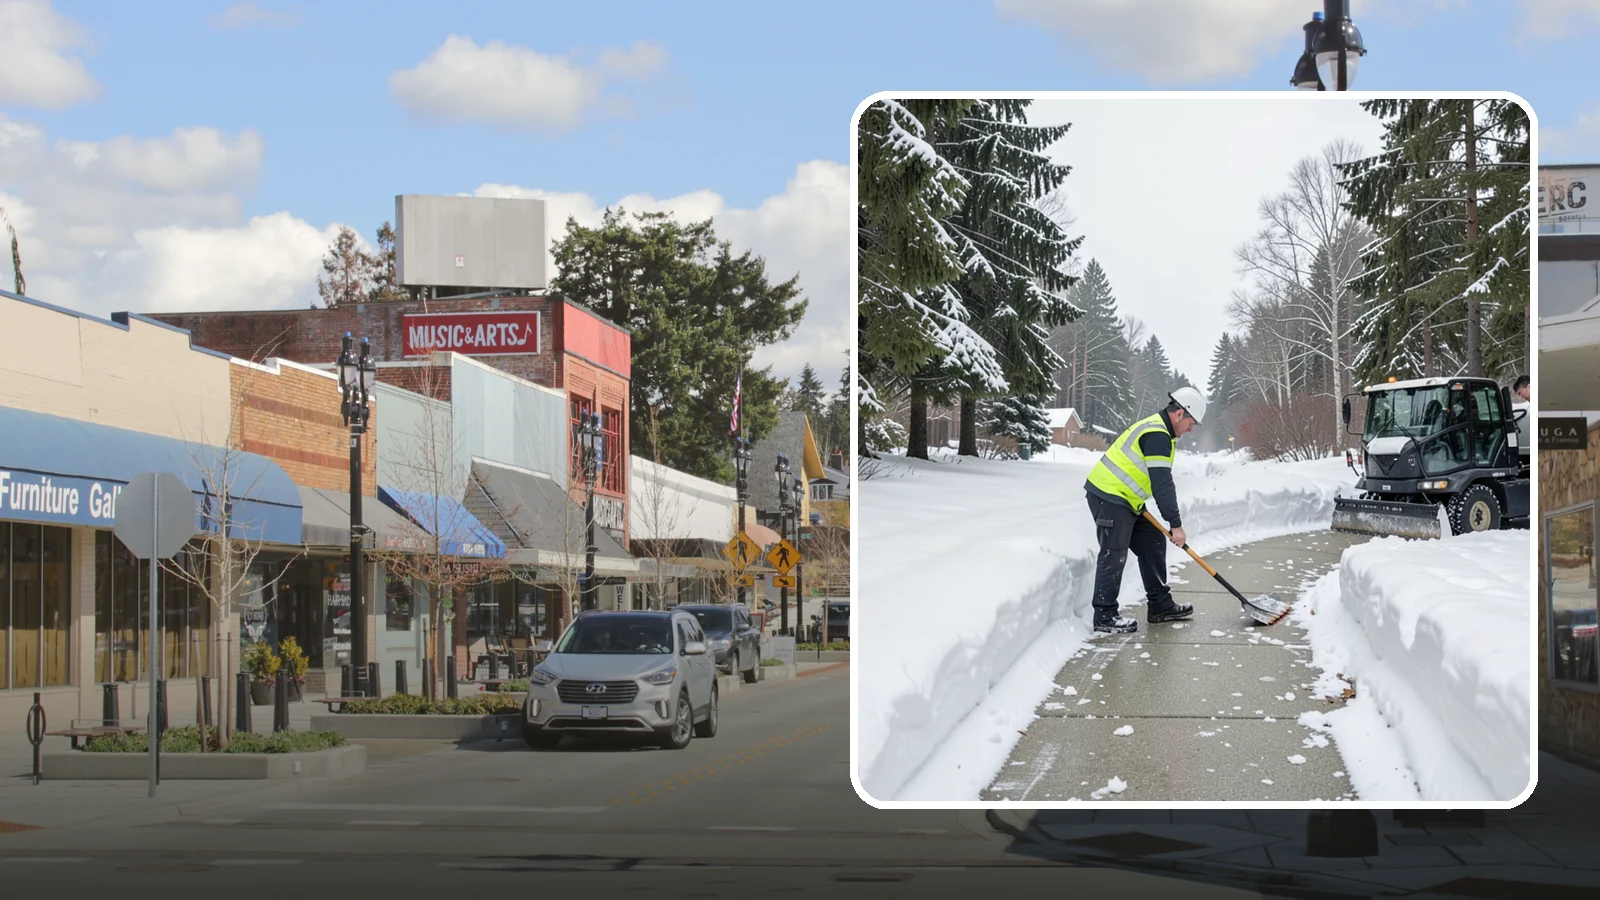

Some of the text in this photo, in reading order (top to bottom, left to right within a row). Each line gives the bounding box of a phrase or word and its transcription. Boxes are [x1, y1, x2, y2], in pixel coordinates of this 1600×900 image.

[1540, 427, 1577, 436] UGA
[0, 471, 121, 519] Furniture Gal
